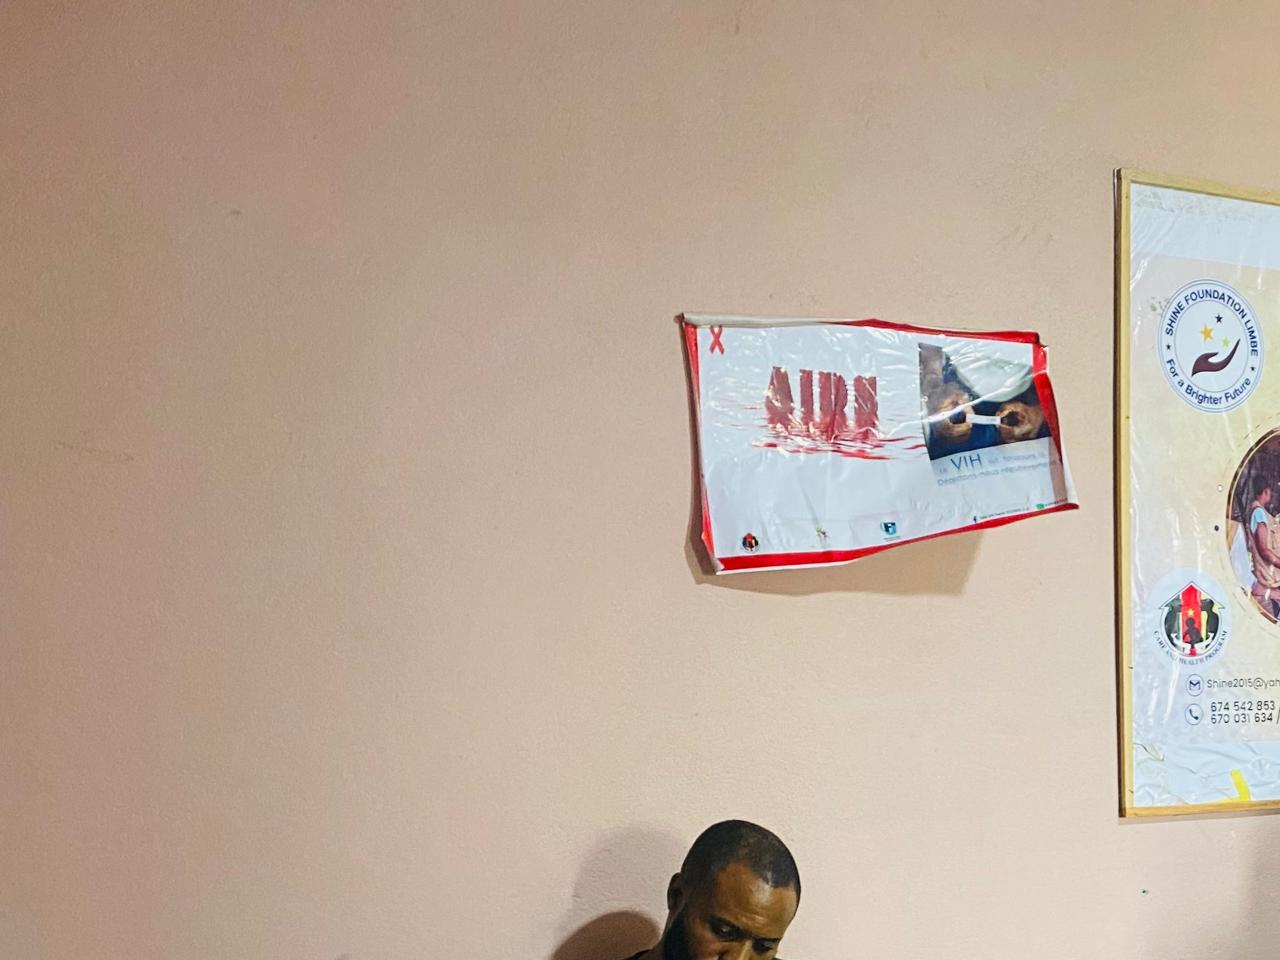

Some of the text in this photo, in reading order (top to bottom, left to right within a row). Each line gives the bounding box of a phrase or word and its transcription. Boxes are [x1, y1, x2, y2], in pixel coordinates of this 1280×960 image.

[1165, 289, 1259, 357] SHINE FOUNDATION LIMBE
[1166, 359, 1252, 405] For a Brighter Future
[950, 453, 983, 471] VIH
[1210, 701, 1230, 713] 674
[1233, 701, 1253, 712] 542
[1256, 700, 1276, 711] 853
[1210, 713, 1230, 724] 670
[1233, 713, 1251, 724] 031
[1254, 712, 1273, 723] 634
